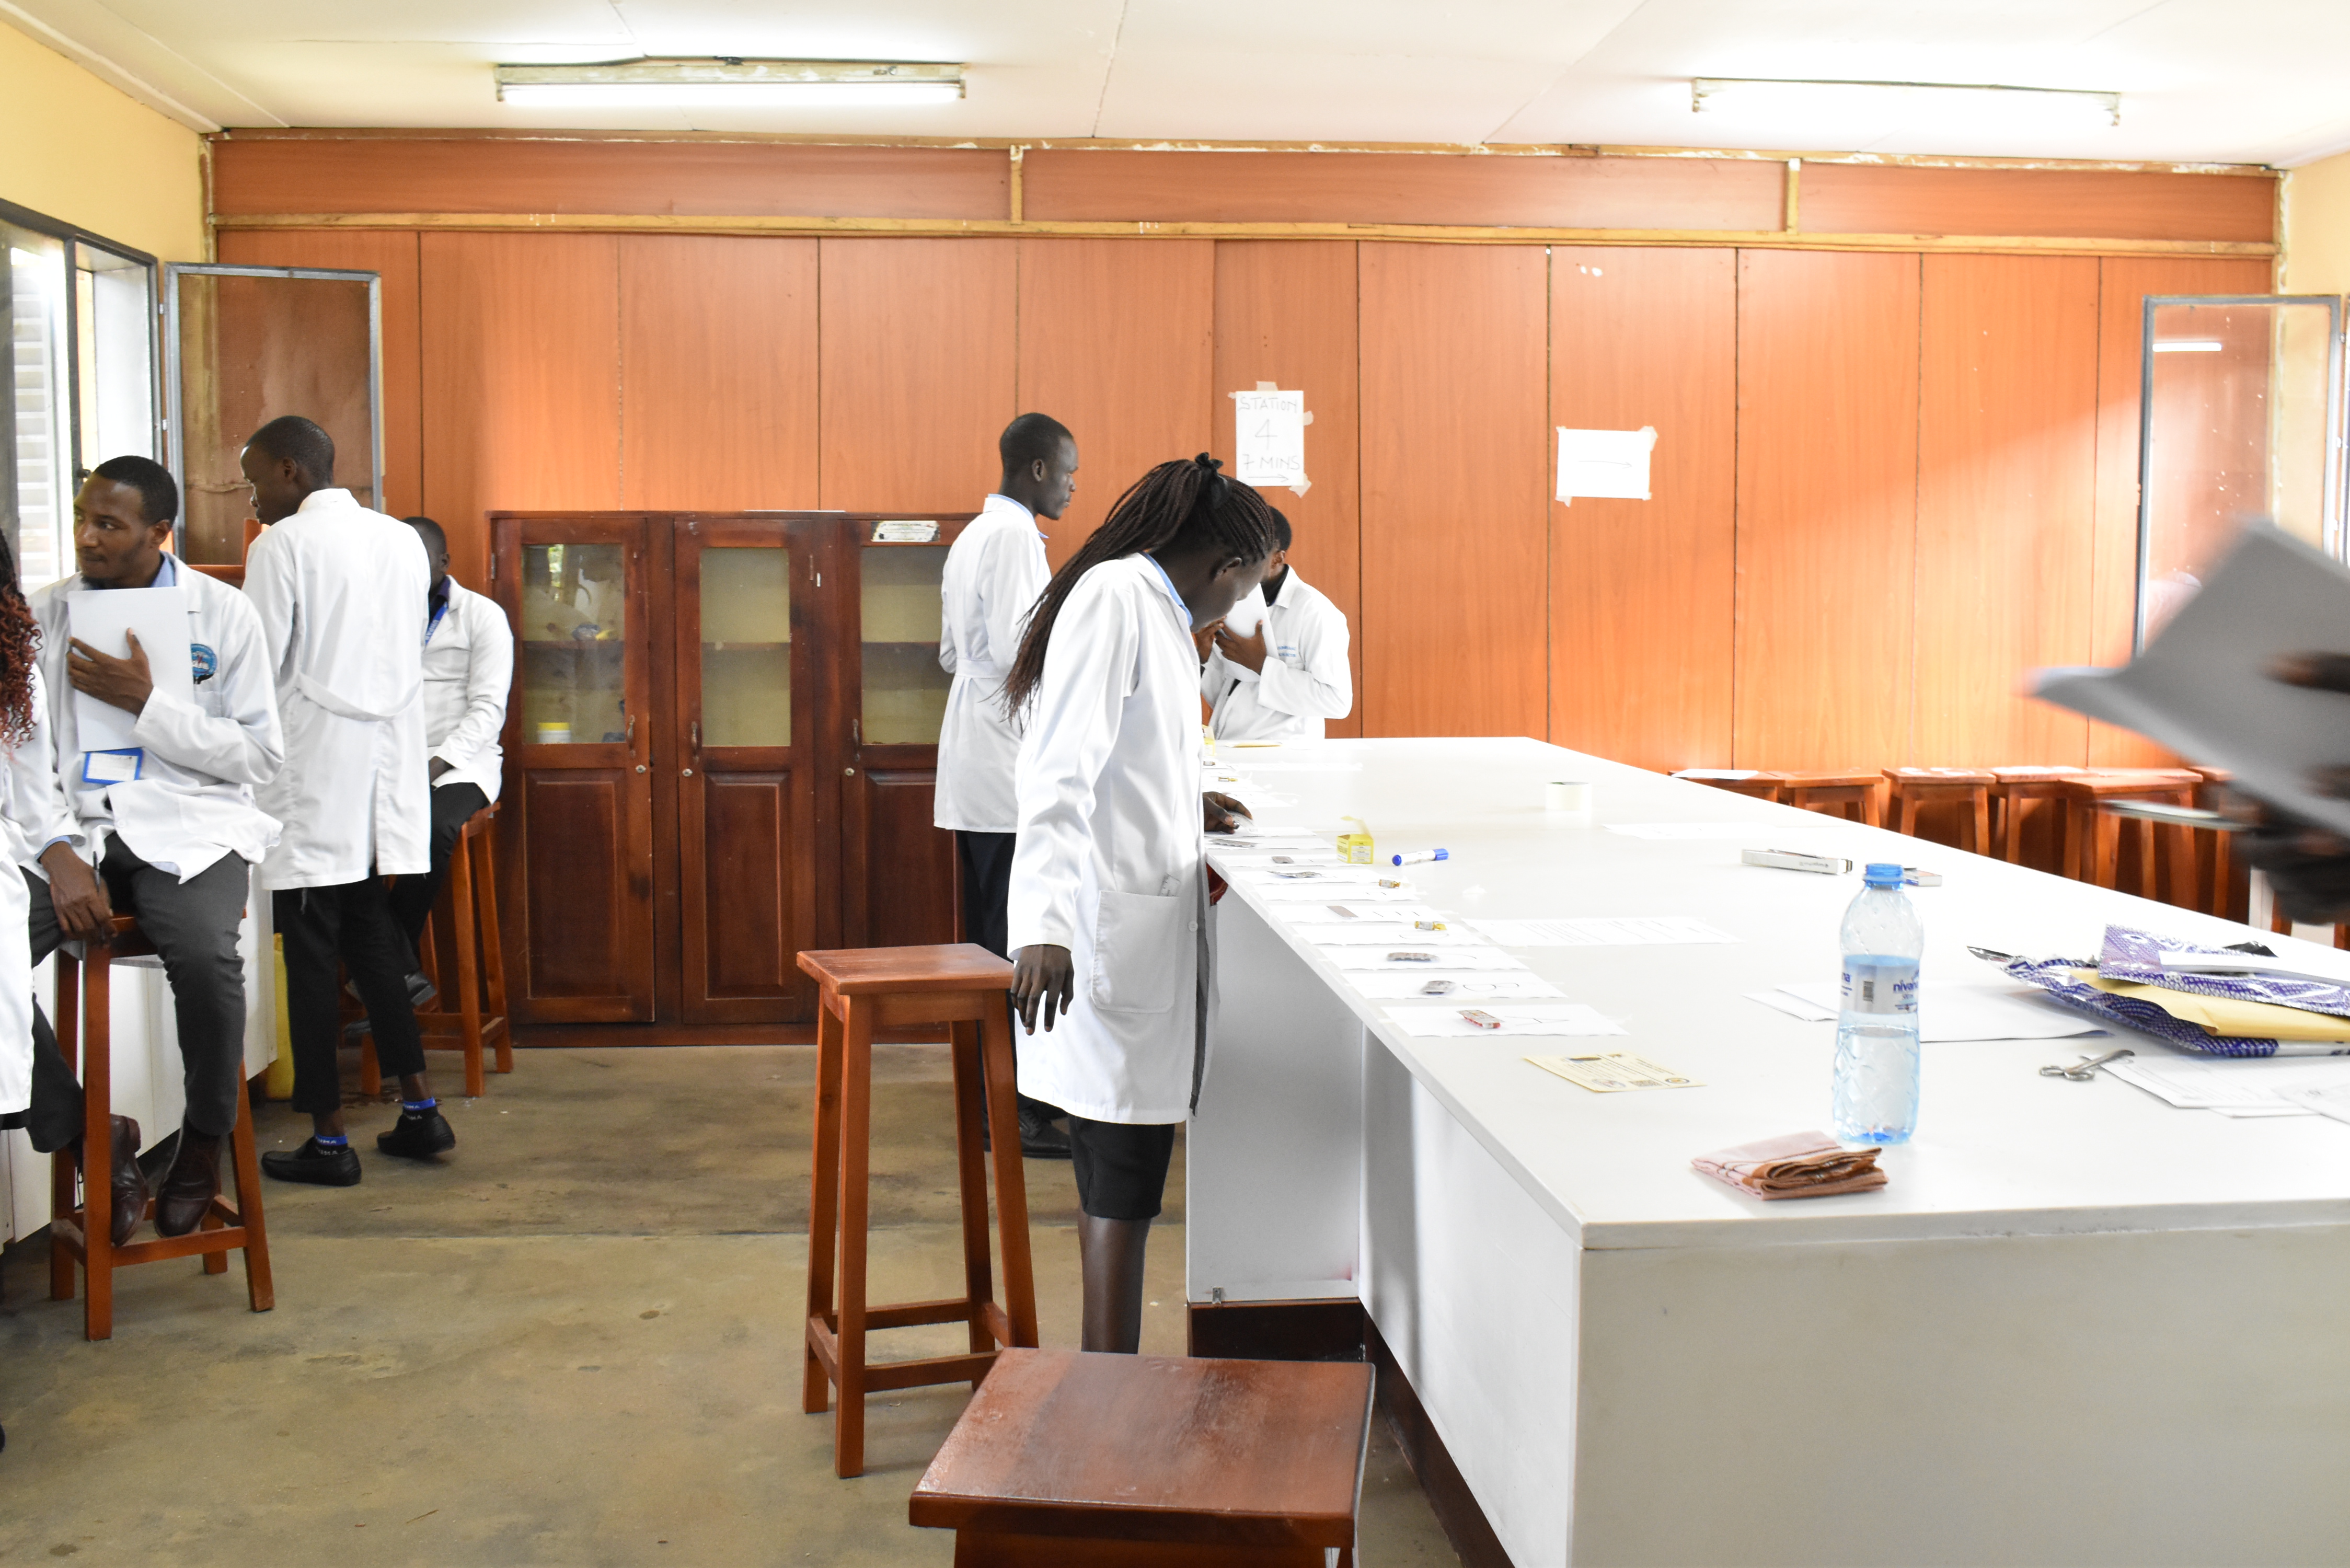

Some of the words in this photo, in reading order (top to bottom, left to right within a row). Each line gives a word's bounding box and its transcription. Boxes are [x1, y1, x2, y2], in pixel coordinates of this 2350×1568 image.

[1238, 397, 1297, 413] STATION
[1254, 418, 1278, 451] 4
[1242, 453, 1254, 470] 7
[1259, 455, 1300, 470] MINS
[1462, 982, 1520, 992] B
[1504, 1016, 1570, 1026] A
